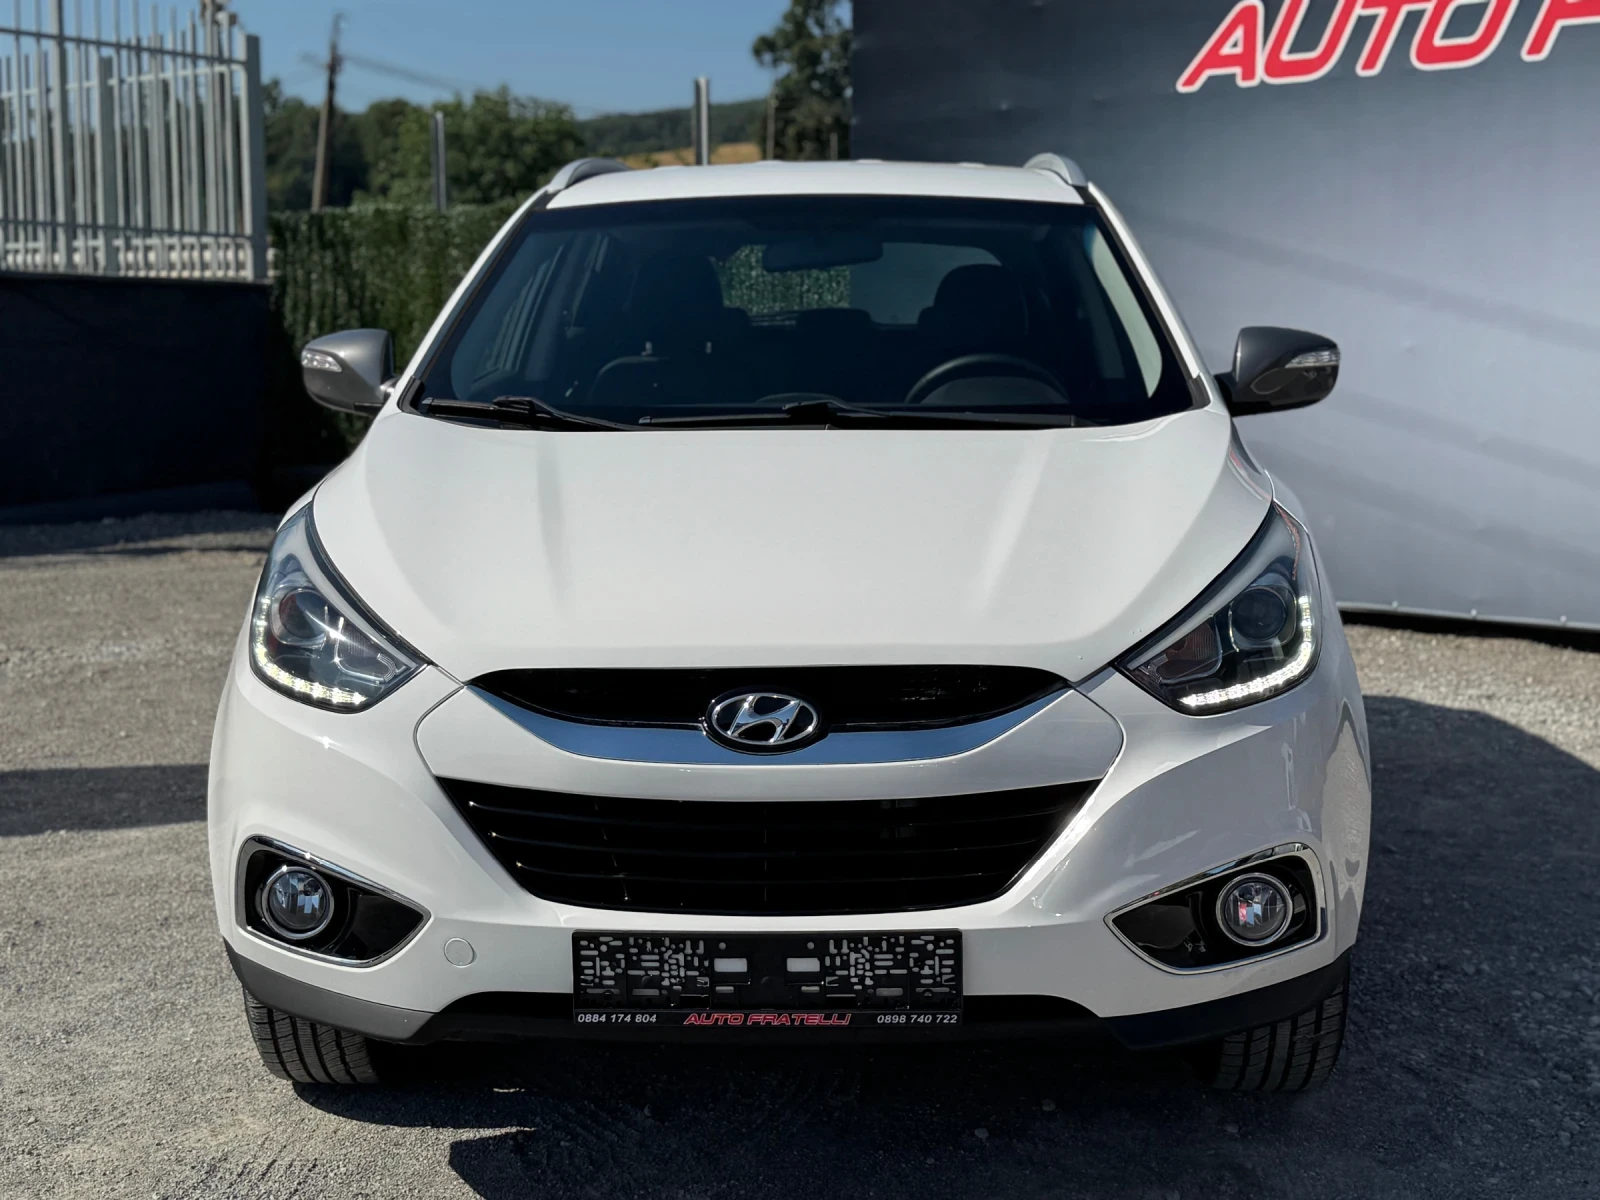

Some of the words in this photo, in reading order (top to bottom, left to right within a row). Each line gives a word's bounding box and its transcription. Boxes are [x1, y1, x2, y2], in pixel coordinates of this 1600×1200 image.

[1175, 0, 1516, 93] AUTO
[577, 1013, 607, 1023] 0884
[610, 1013, 632, 1023] 174
[634, 1013, 657, 1023] 804
[683, 1013, 744, 1025] AUTO
[746, 1013, 852, 1025] FRATELLI
[876, 1014, 907, 1024] 0898
[909, 1014, 932, 1024] 740
[935, 1014, 958, 1024] 722
